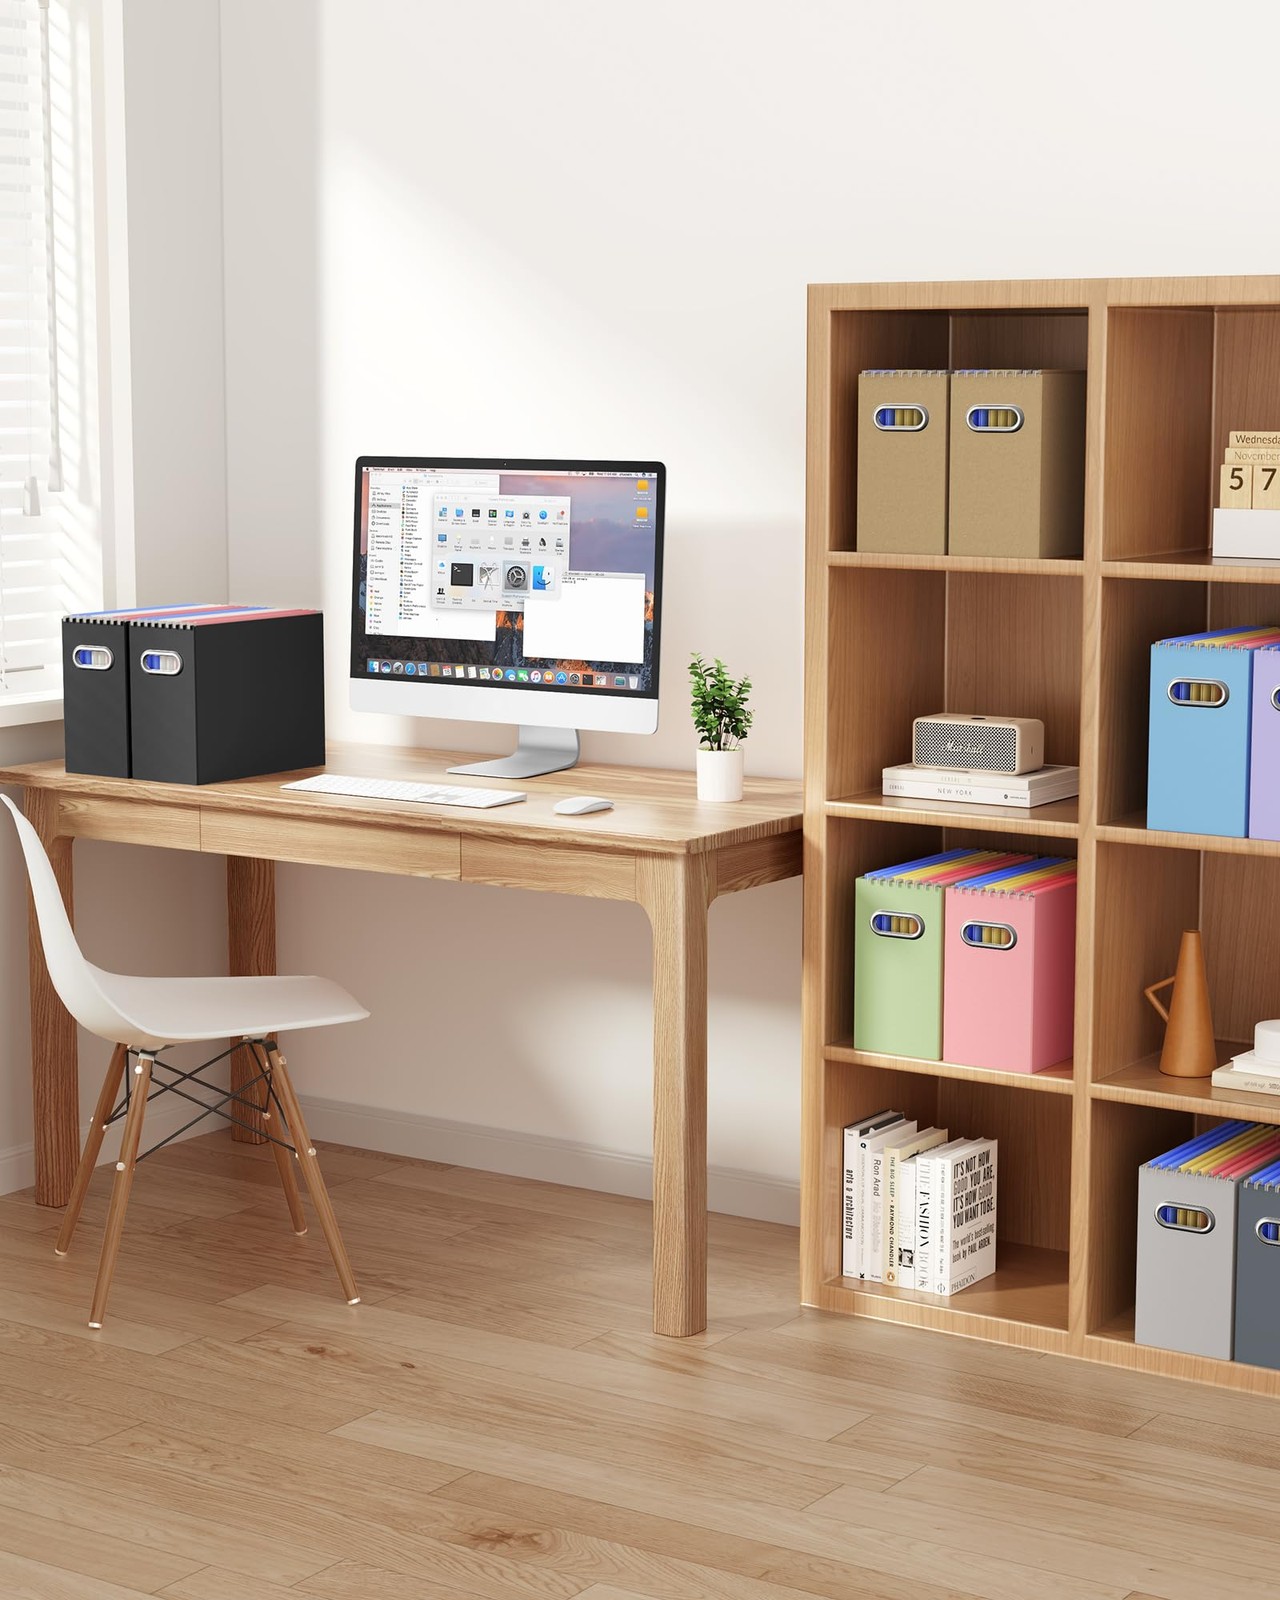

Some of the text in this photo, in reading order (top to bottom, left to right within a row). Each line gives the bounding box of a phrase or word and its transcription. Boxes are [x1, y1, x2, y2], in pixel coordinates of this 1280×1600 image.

[1230, 468, 1277, 490] 5 7
[920, 1162, 930, 1188] THE
[954, 1149, 990, 1179] IT'S NOT HOW
[954, 1176, 968, 1195] GOOD
[970, 1170, 980, 1187] YOU
[954, 1181, 992, 1212] IT'S HOW GOOD
[846, 1196, 854, 1240] architecture
[919, 1191, 930, 1247] FASHION
[953, 1211, 963, 1229] YOU
[965, 1204, 979, 1223] WANT
[961, 1232, 973, 1246] world's
[953, 1251, 961, 1263] book
[962, 1248, 967, 1260] by
[968, 1242, 977, 1256] PAUL
[952, 1274, 975, 1292] PHAIDON
